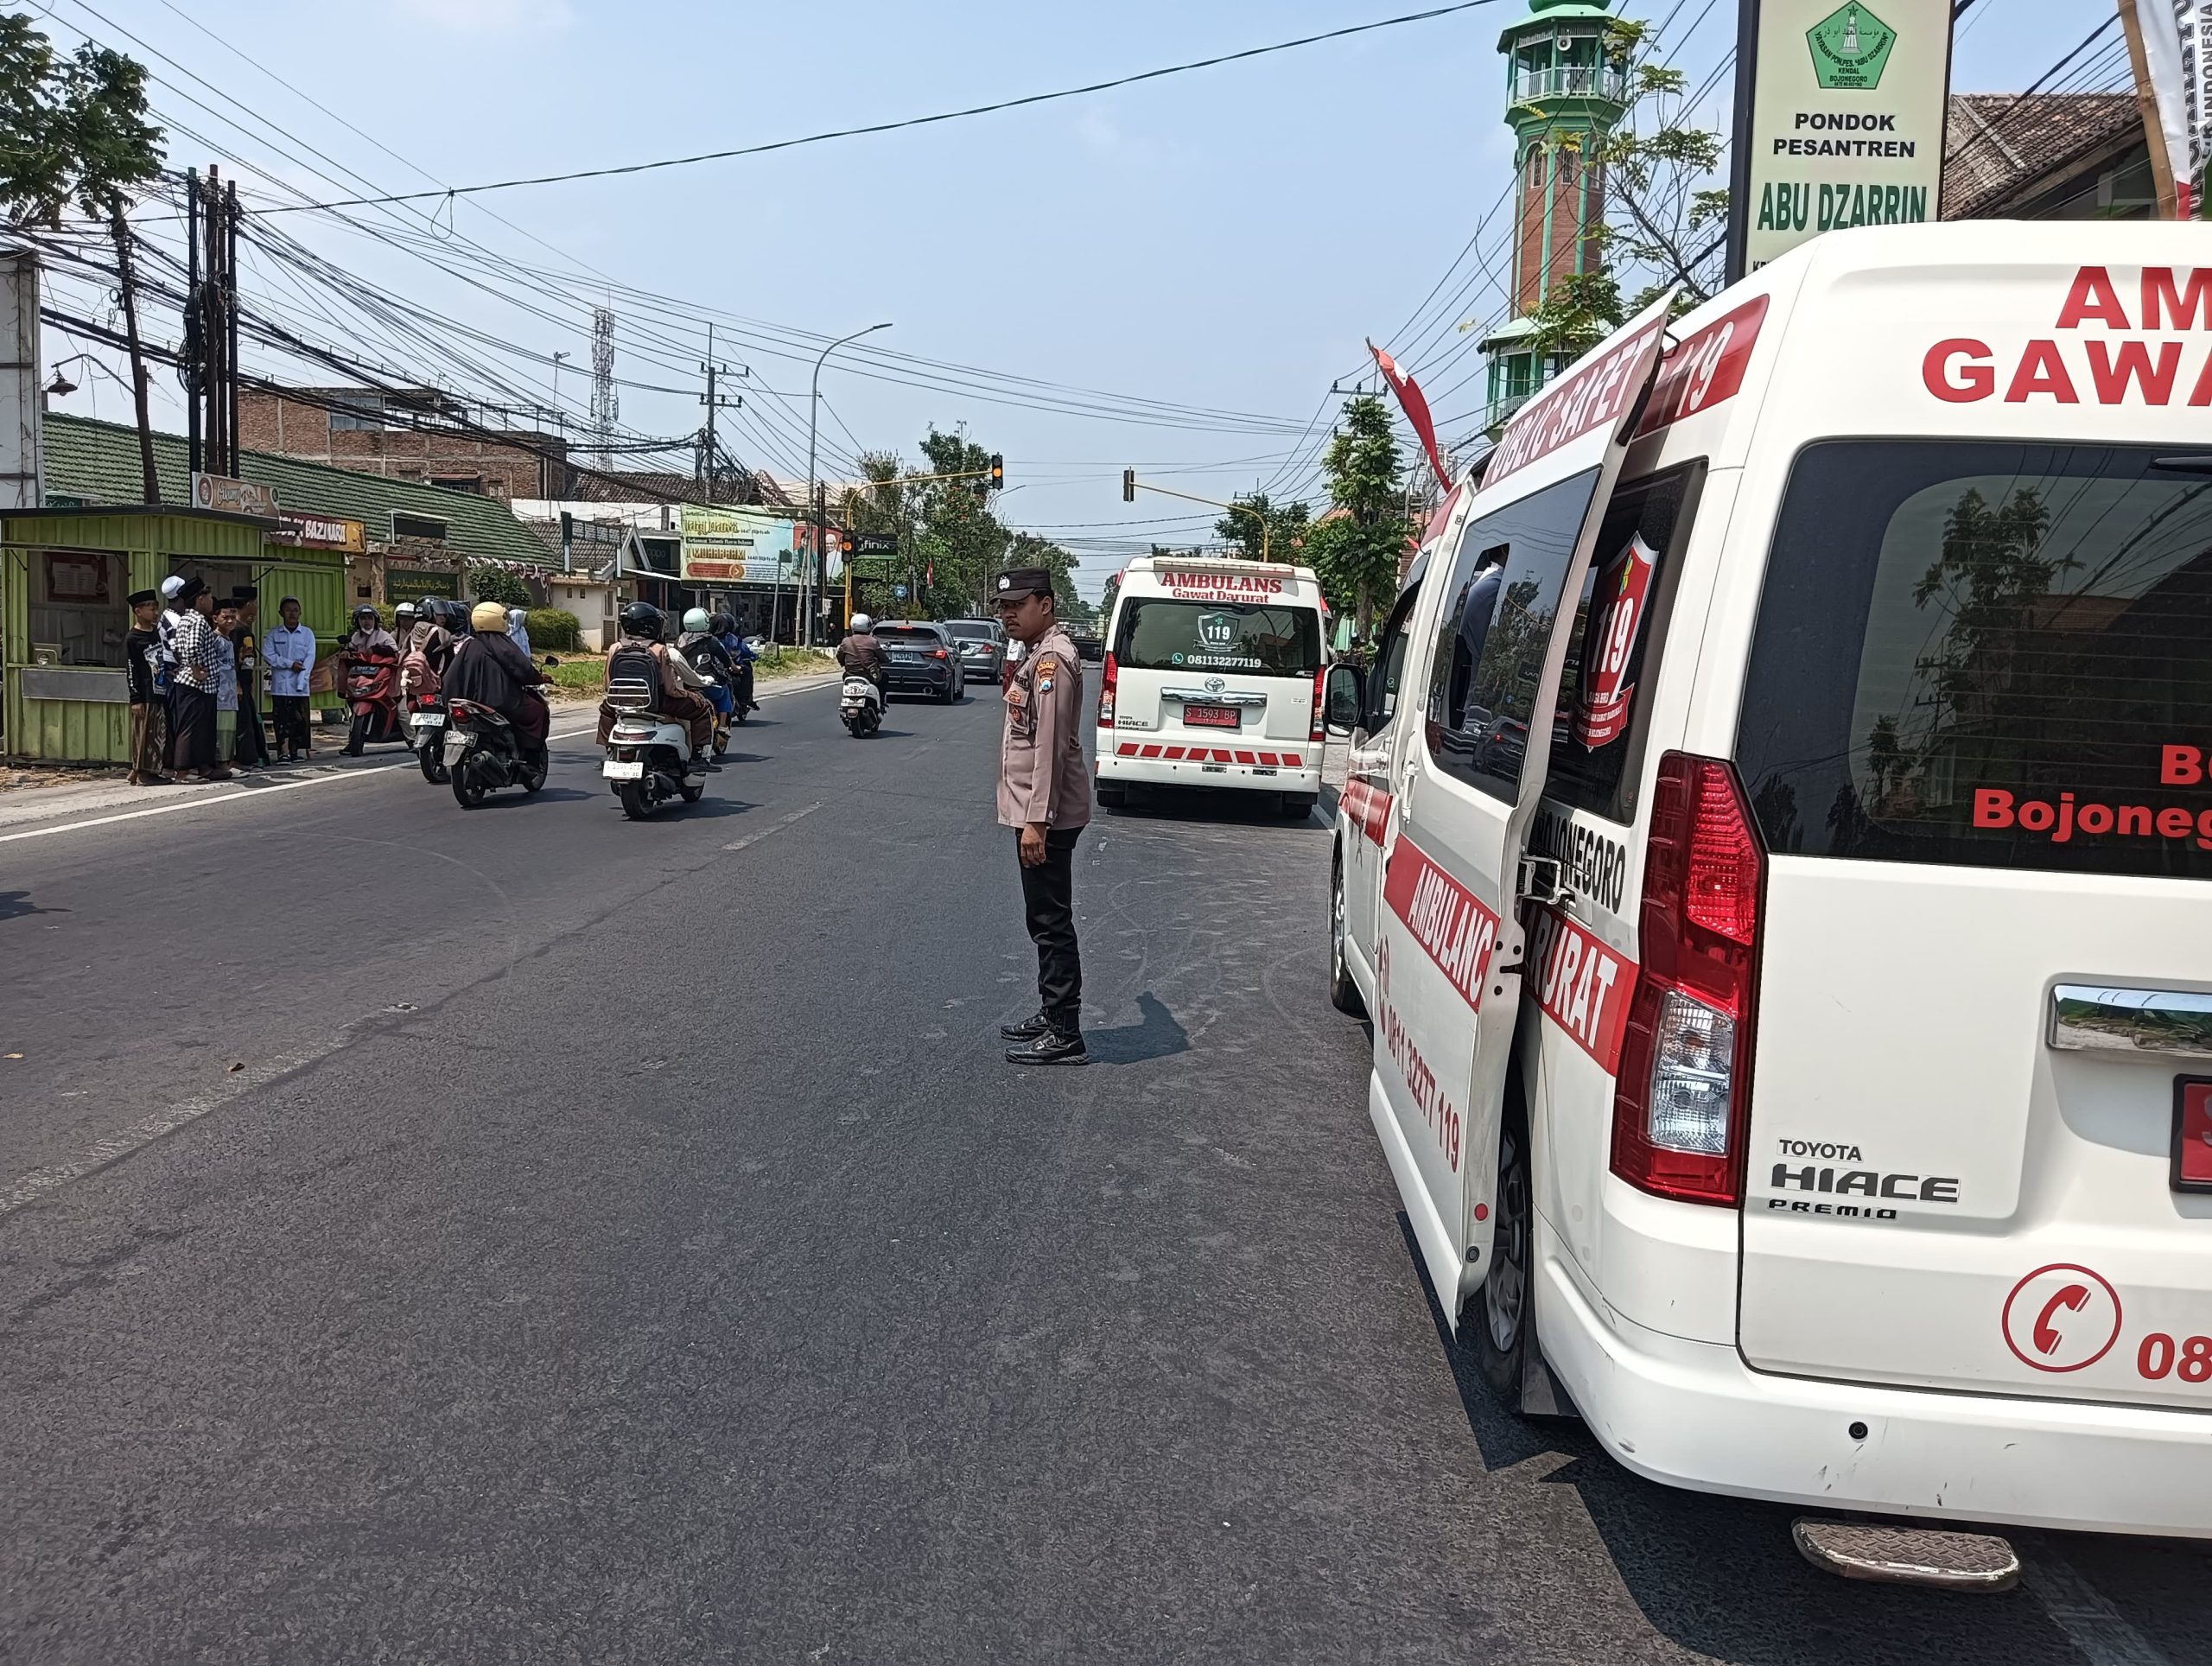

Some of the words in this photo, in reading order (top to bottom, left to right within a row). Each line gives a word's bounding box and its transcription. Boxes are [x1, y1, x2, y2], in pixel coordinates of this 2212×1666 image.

[1815, 31, 1833, 59] YAYASAN
[1795, 113, 1896, 130] PONDOK
[1773, 139, 1916, 157] PESANTREN
[1757, 182, 1810, 232] ABU
[1817, 183, 1927, 232] DZARRIN
[1656, 321, 1734, 425] 119
[1480, 391, 1565, 490] PUBLIC
[1160, 573, 1282, 594] AMBULANS
[1173, 588, 1215, 601] Gawat
[1217, 591, 1269, 603] Darurat
[1207, 626, 1230, 639] 119
[1592, 598, 1634, 673] 119
[1187, 655, 1262, 668] 081132277119
[1185, 708, 1192, 716] S
[1197, 709, 1219, 719] 1593
[1224, 710, 1236, 720] BP
[1388, 1004, 1406, 1076] 0811
[1407, 1038, 1436, 1129] 32277
[1438, 1091, 1460, 1173] 119
[1779, 1139, 1863, 1161] TOYOTA
[1771, 1163, 1959, 1203] HIACE
[1768, 1199, 1897, 1219] PREMIO
